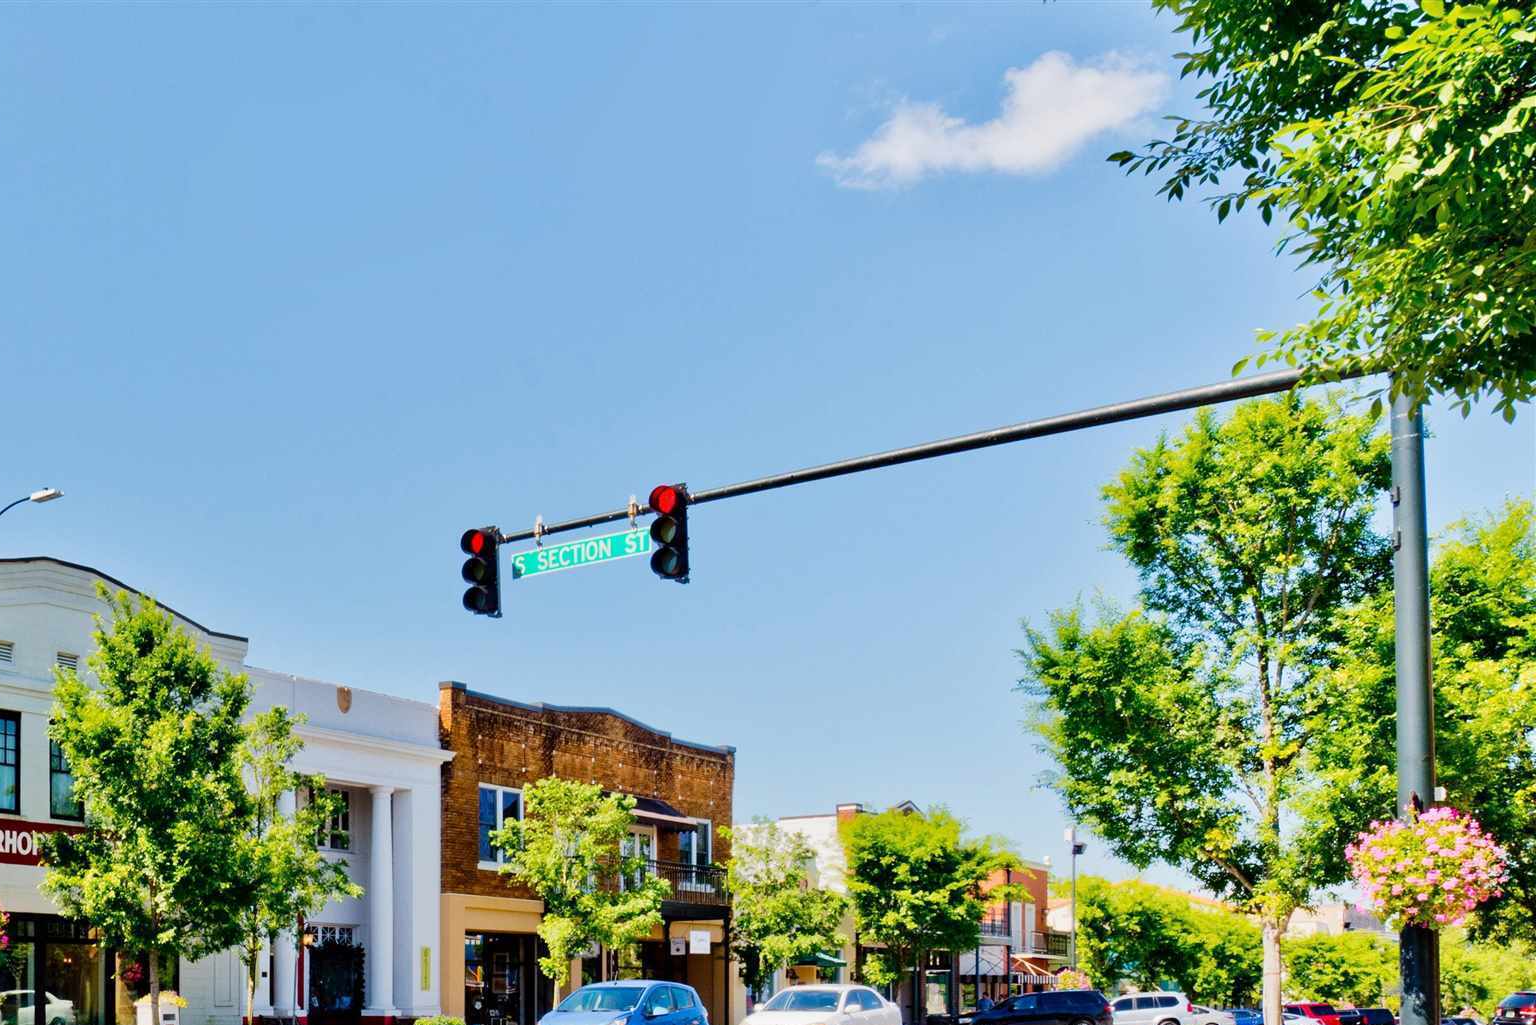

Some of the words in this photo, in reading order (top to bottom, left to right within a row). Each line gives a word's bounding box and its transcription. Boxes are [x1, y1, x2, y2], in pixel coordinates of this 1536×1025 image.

[515, 556, 526, 574] S
[537, 538, 612, 571] SECTION
[625, 531, 649, 553] ST
